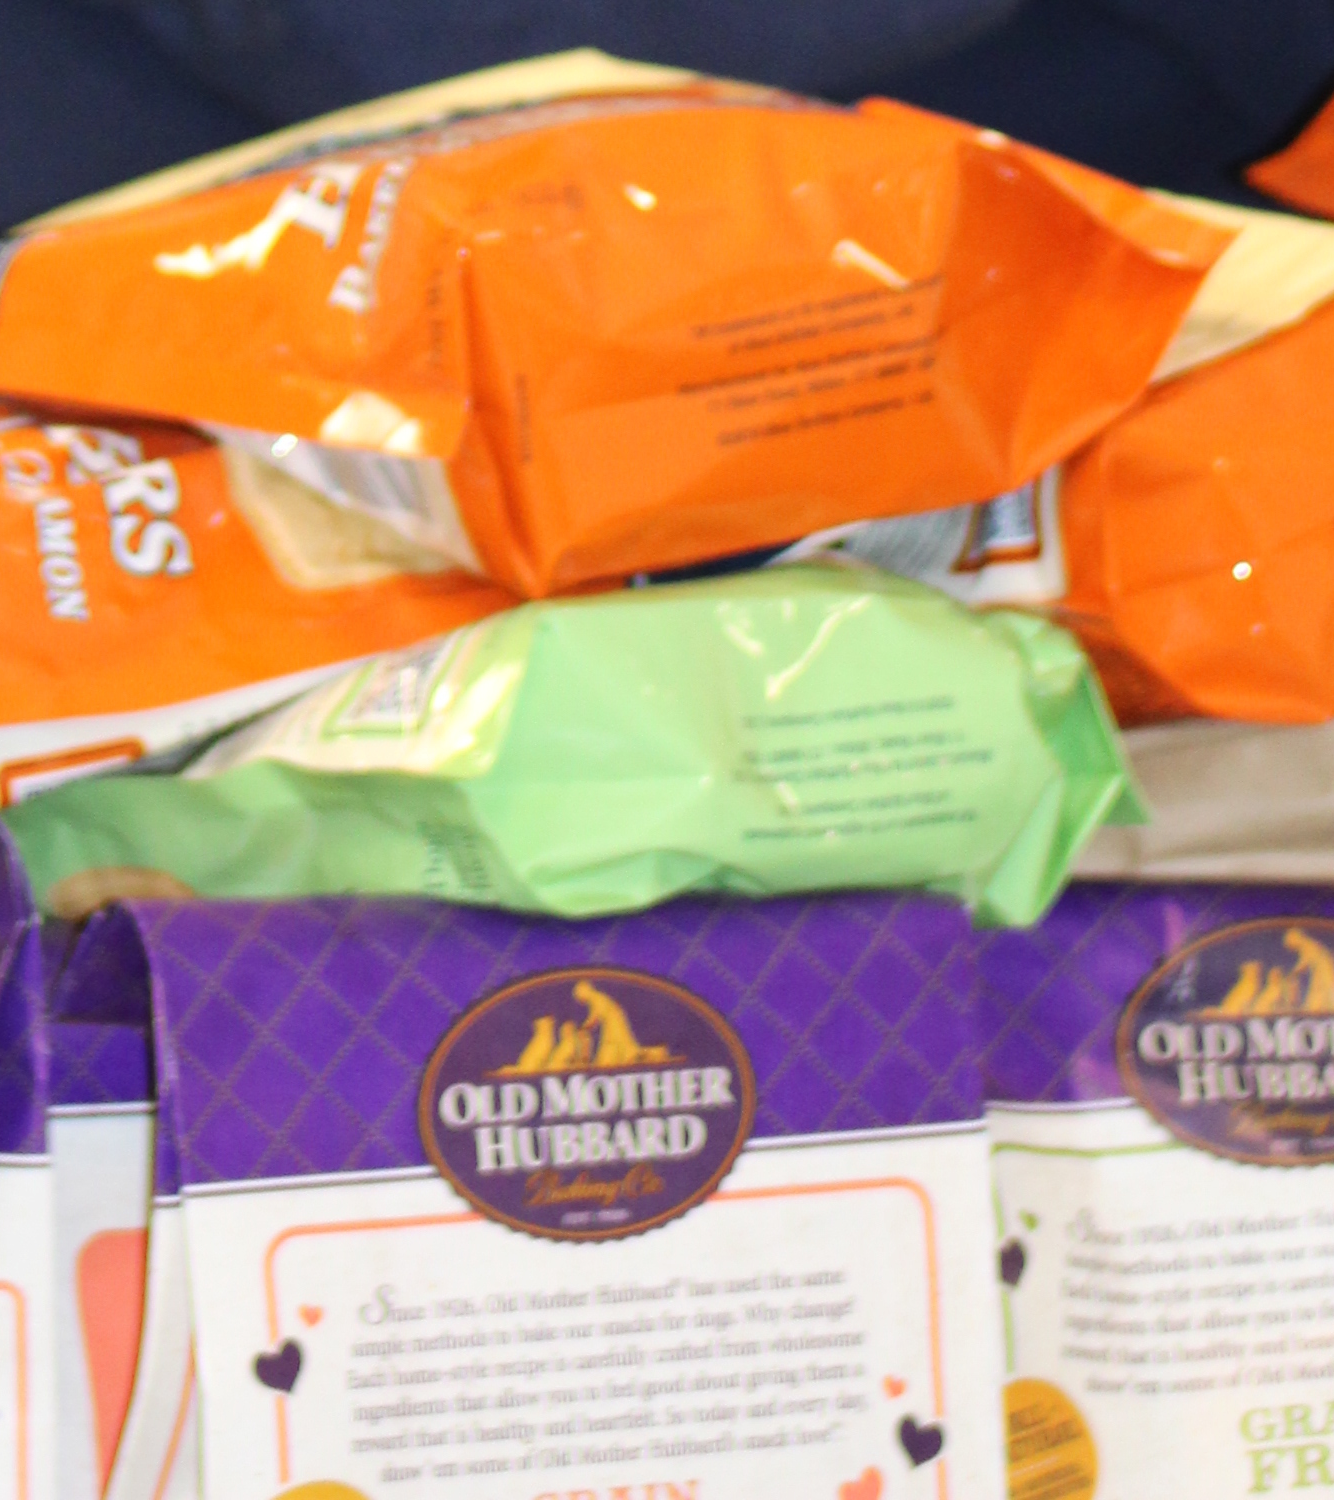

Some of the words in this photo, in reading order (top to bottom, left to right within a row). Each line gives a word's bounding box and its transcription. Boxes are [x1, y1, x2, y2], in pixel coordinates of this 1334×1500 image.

[1137, 1020, 1245, 1064] OLD
[438, 1081, 539, 1130] OLD
[541, 1065, 736, 1121] MOTHER
[474, 1113, 708, 1176] HUBBARD
